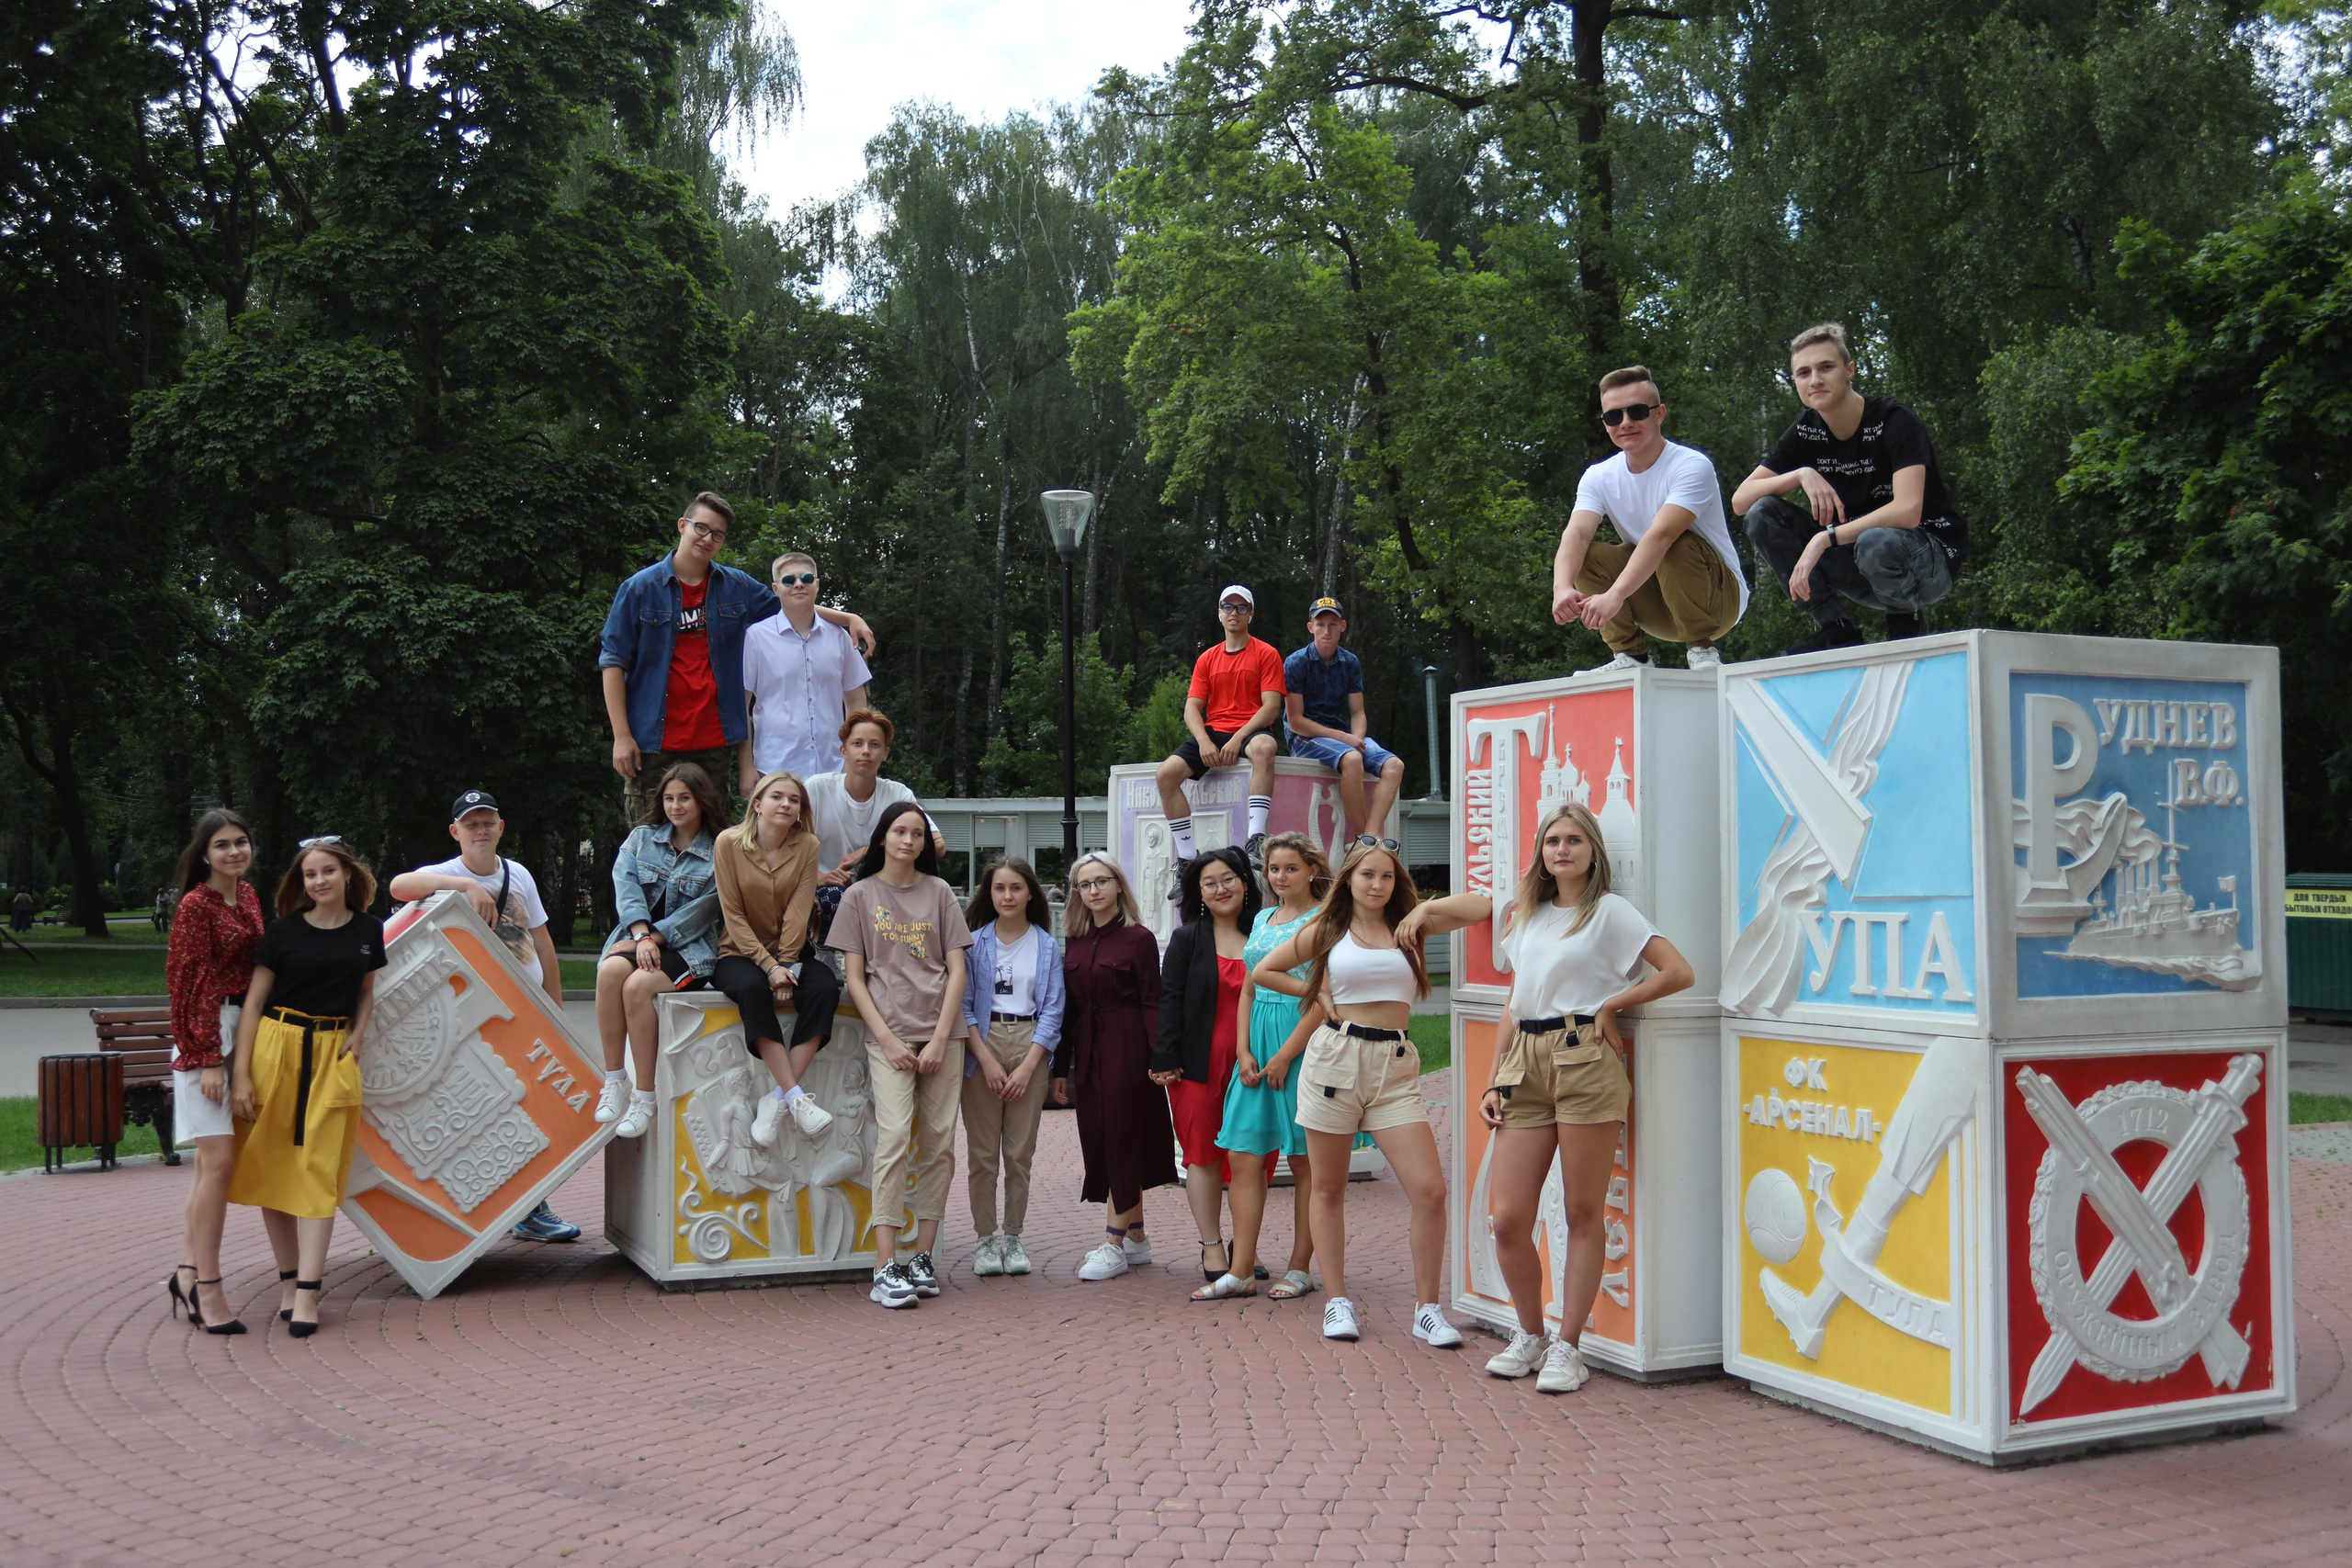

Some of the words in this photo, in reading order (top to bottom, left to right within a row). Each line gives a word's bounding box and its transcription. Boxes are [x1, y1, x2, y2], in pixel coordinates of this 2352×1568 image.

[2175, 759, 2245, 807] В.Ф.
[2312, 894, 2346, 903] ТВЕРДЫХ
[2323, 906, 2352, 915] ОТХОДО
[874, 922, 891, 931] YOU
[894, 923, 908, 932] ARE
[910, 922, 932, 931] JUST
[900, 933, 924, 943] FUNNY
[1797, 910, 1973, 1003] УПА
[526, 1038, 592, 1114] ТУЛА
[1784, 1056, 1827, 1091] ФК
[2118, 1106, 2169, 1135] 1712
[1868, 1280, 1947, 1342] ТУЛА
[2054, 1250, 2184, 1359] ОРУЖЕЙНЫЙ
[2188, 1233, 2237, 1329] ЗАВОД
